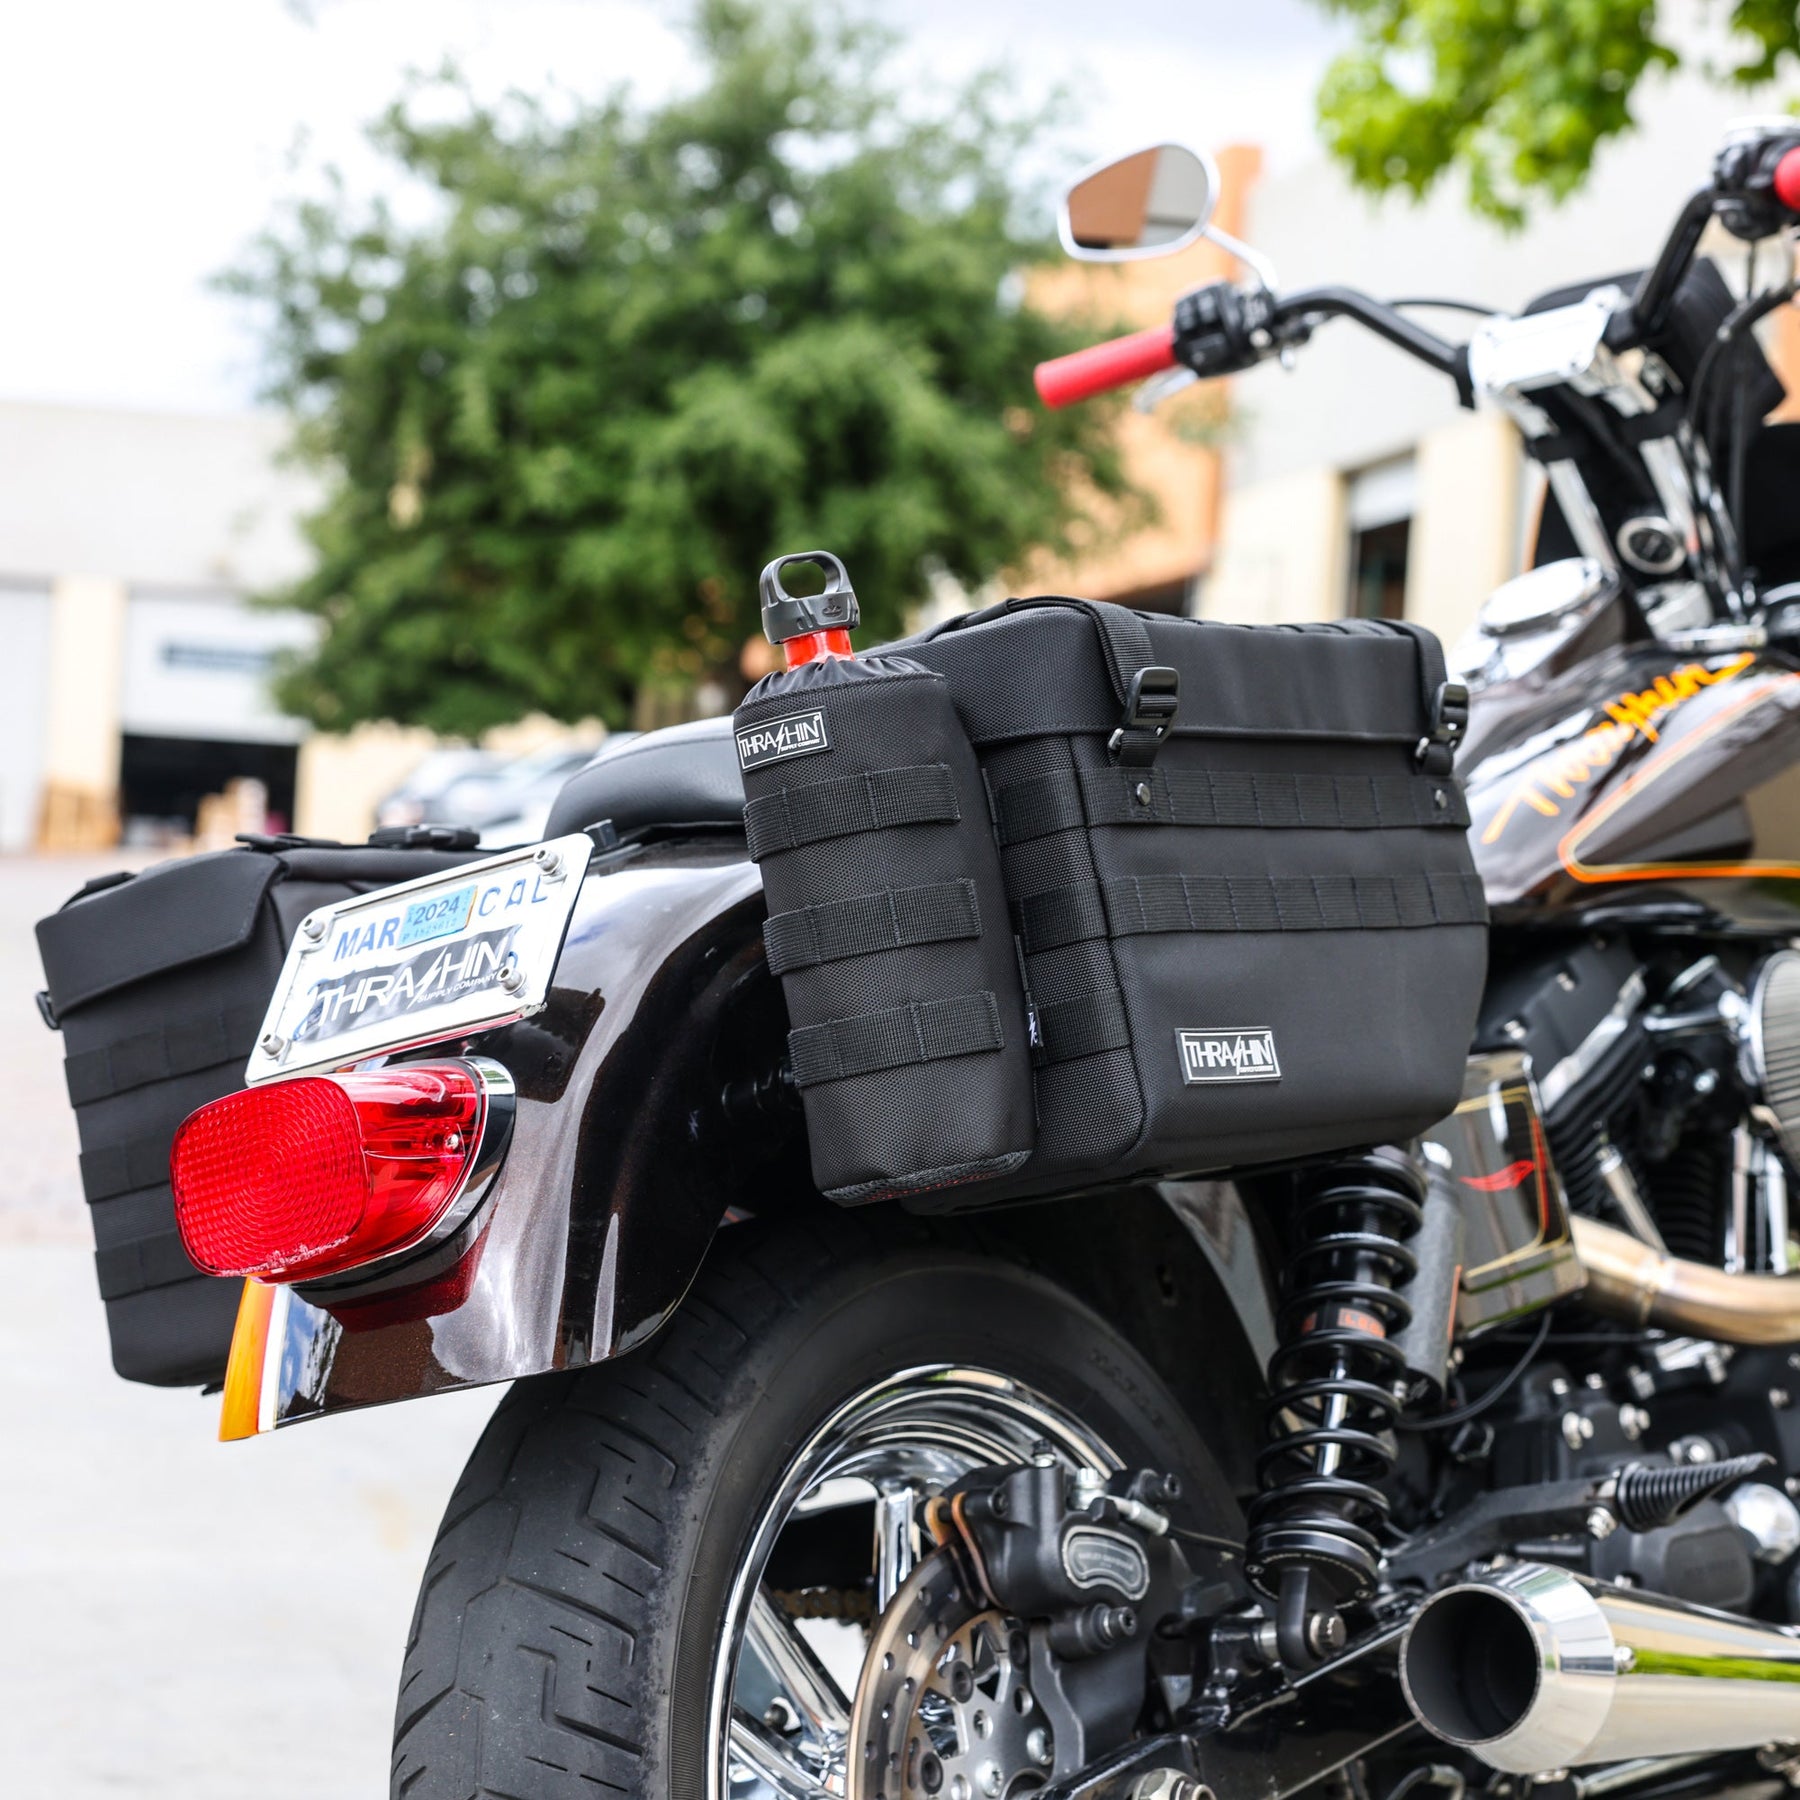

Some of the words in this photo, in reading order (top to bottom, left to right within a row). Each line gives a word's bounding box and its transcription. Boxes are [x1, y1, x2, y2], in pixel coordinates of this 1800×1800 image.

[412, 895, 460, 926] 2024
[333, 917, 400, 962] MAR
[417, 985, 453, 1004] SUPPLY
